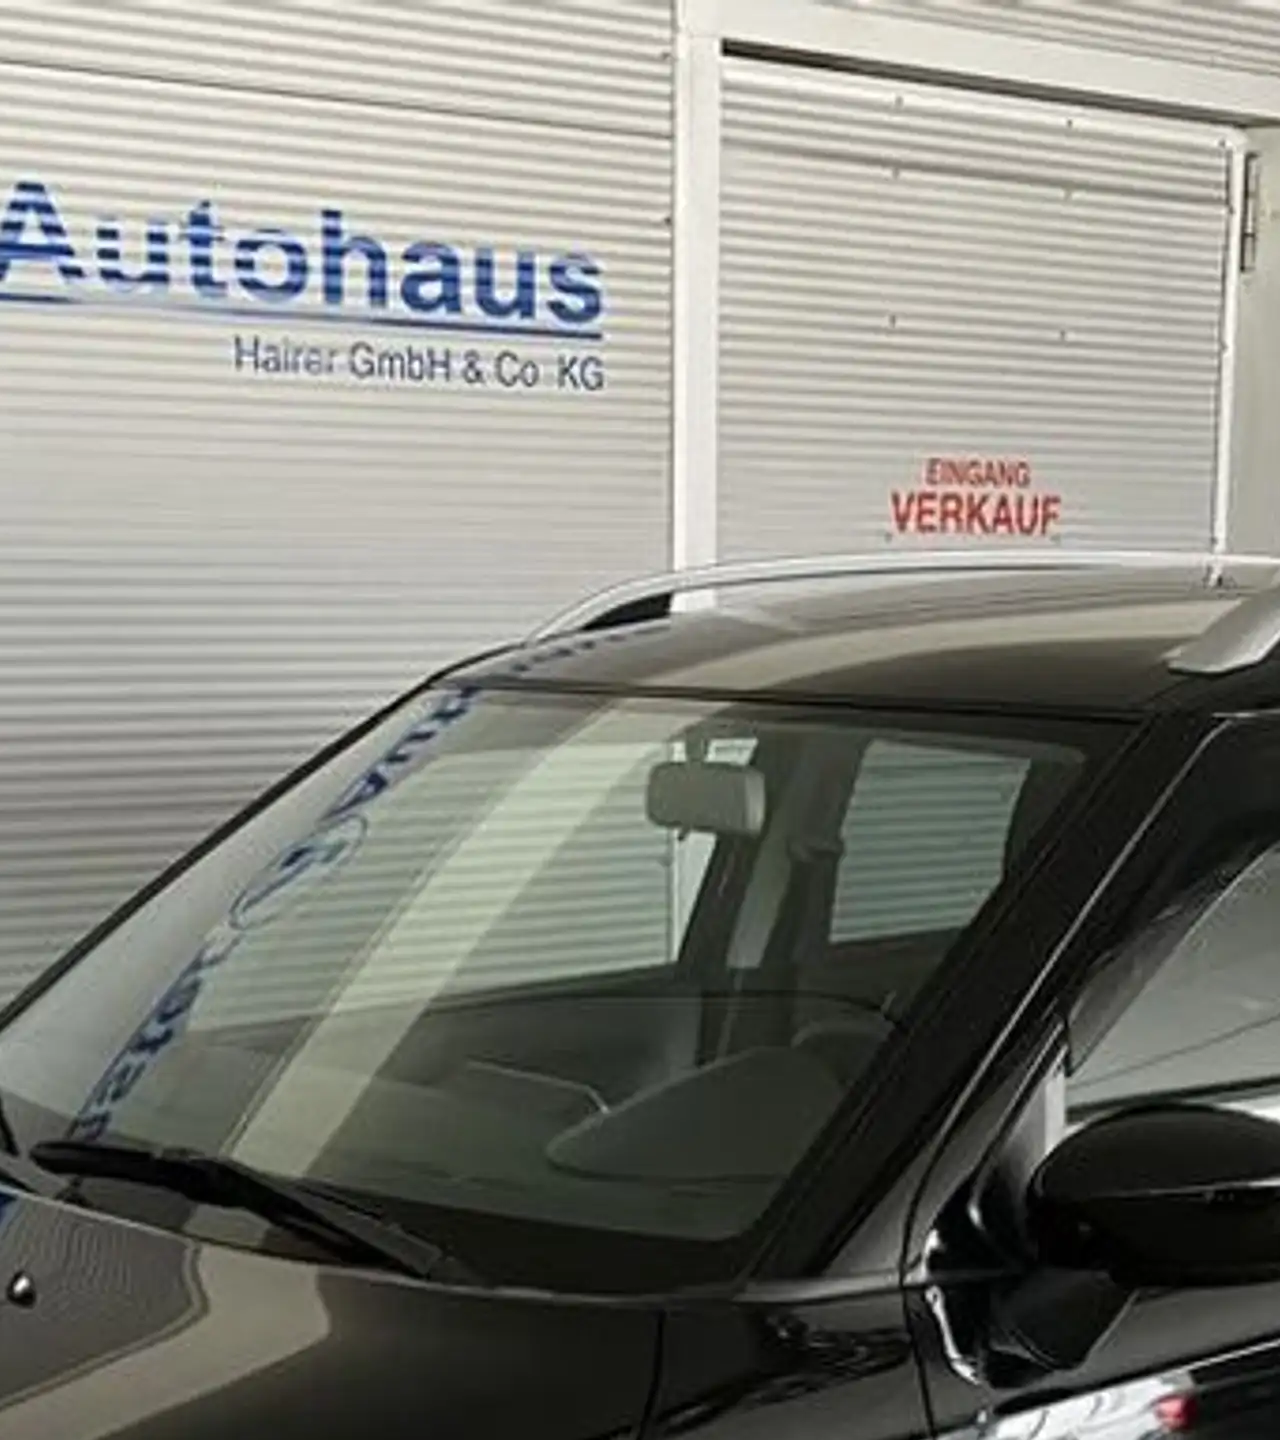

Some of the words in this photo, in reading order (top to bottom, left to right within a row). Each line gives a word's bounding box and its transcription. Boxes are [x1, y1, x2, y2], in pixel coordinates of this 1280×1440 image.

[234, 335, 337, 373] Hairer
[349, 341, 451, 382] GmbH
[462, 350, 486, 384] &
[556, 355, 604, 391] KG
[926, 457, 1031, 488] EINGANG
[890, 491, 1062, 535] VERKAUF
